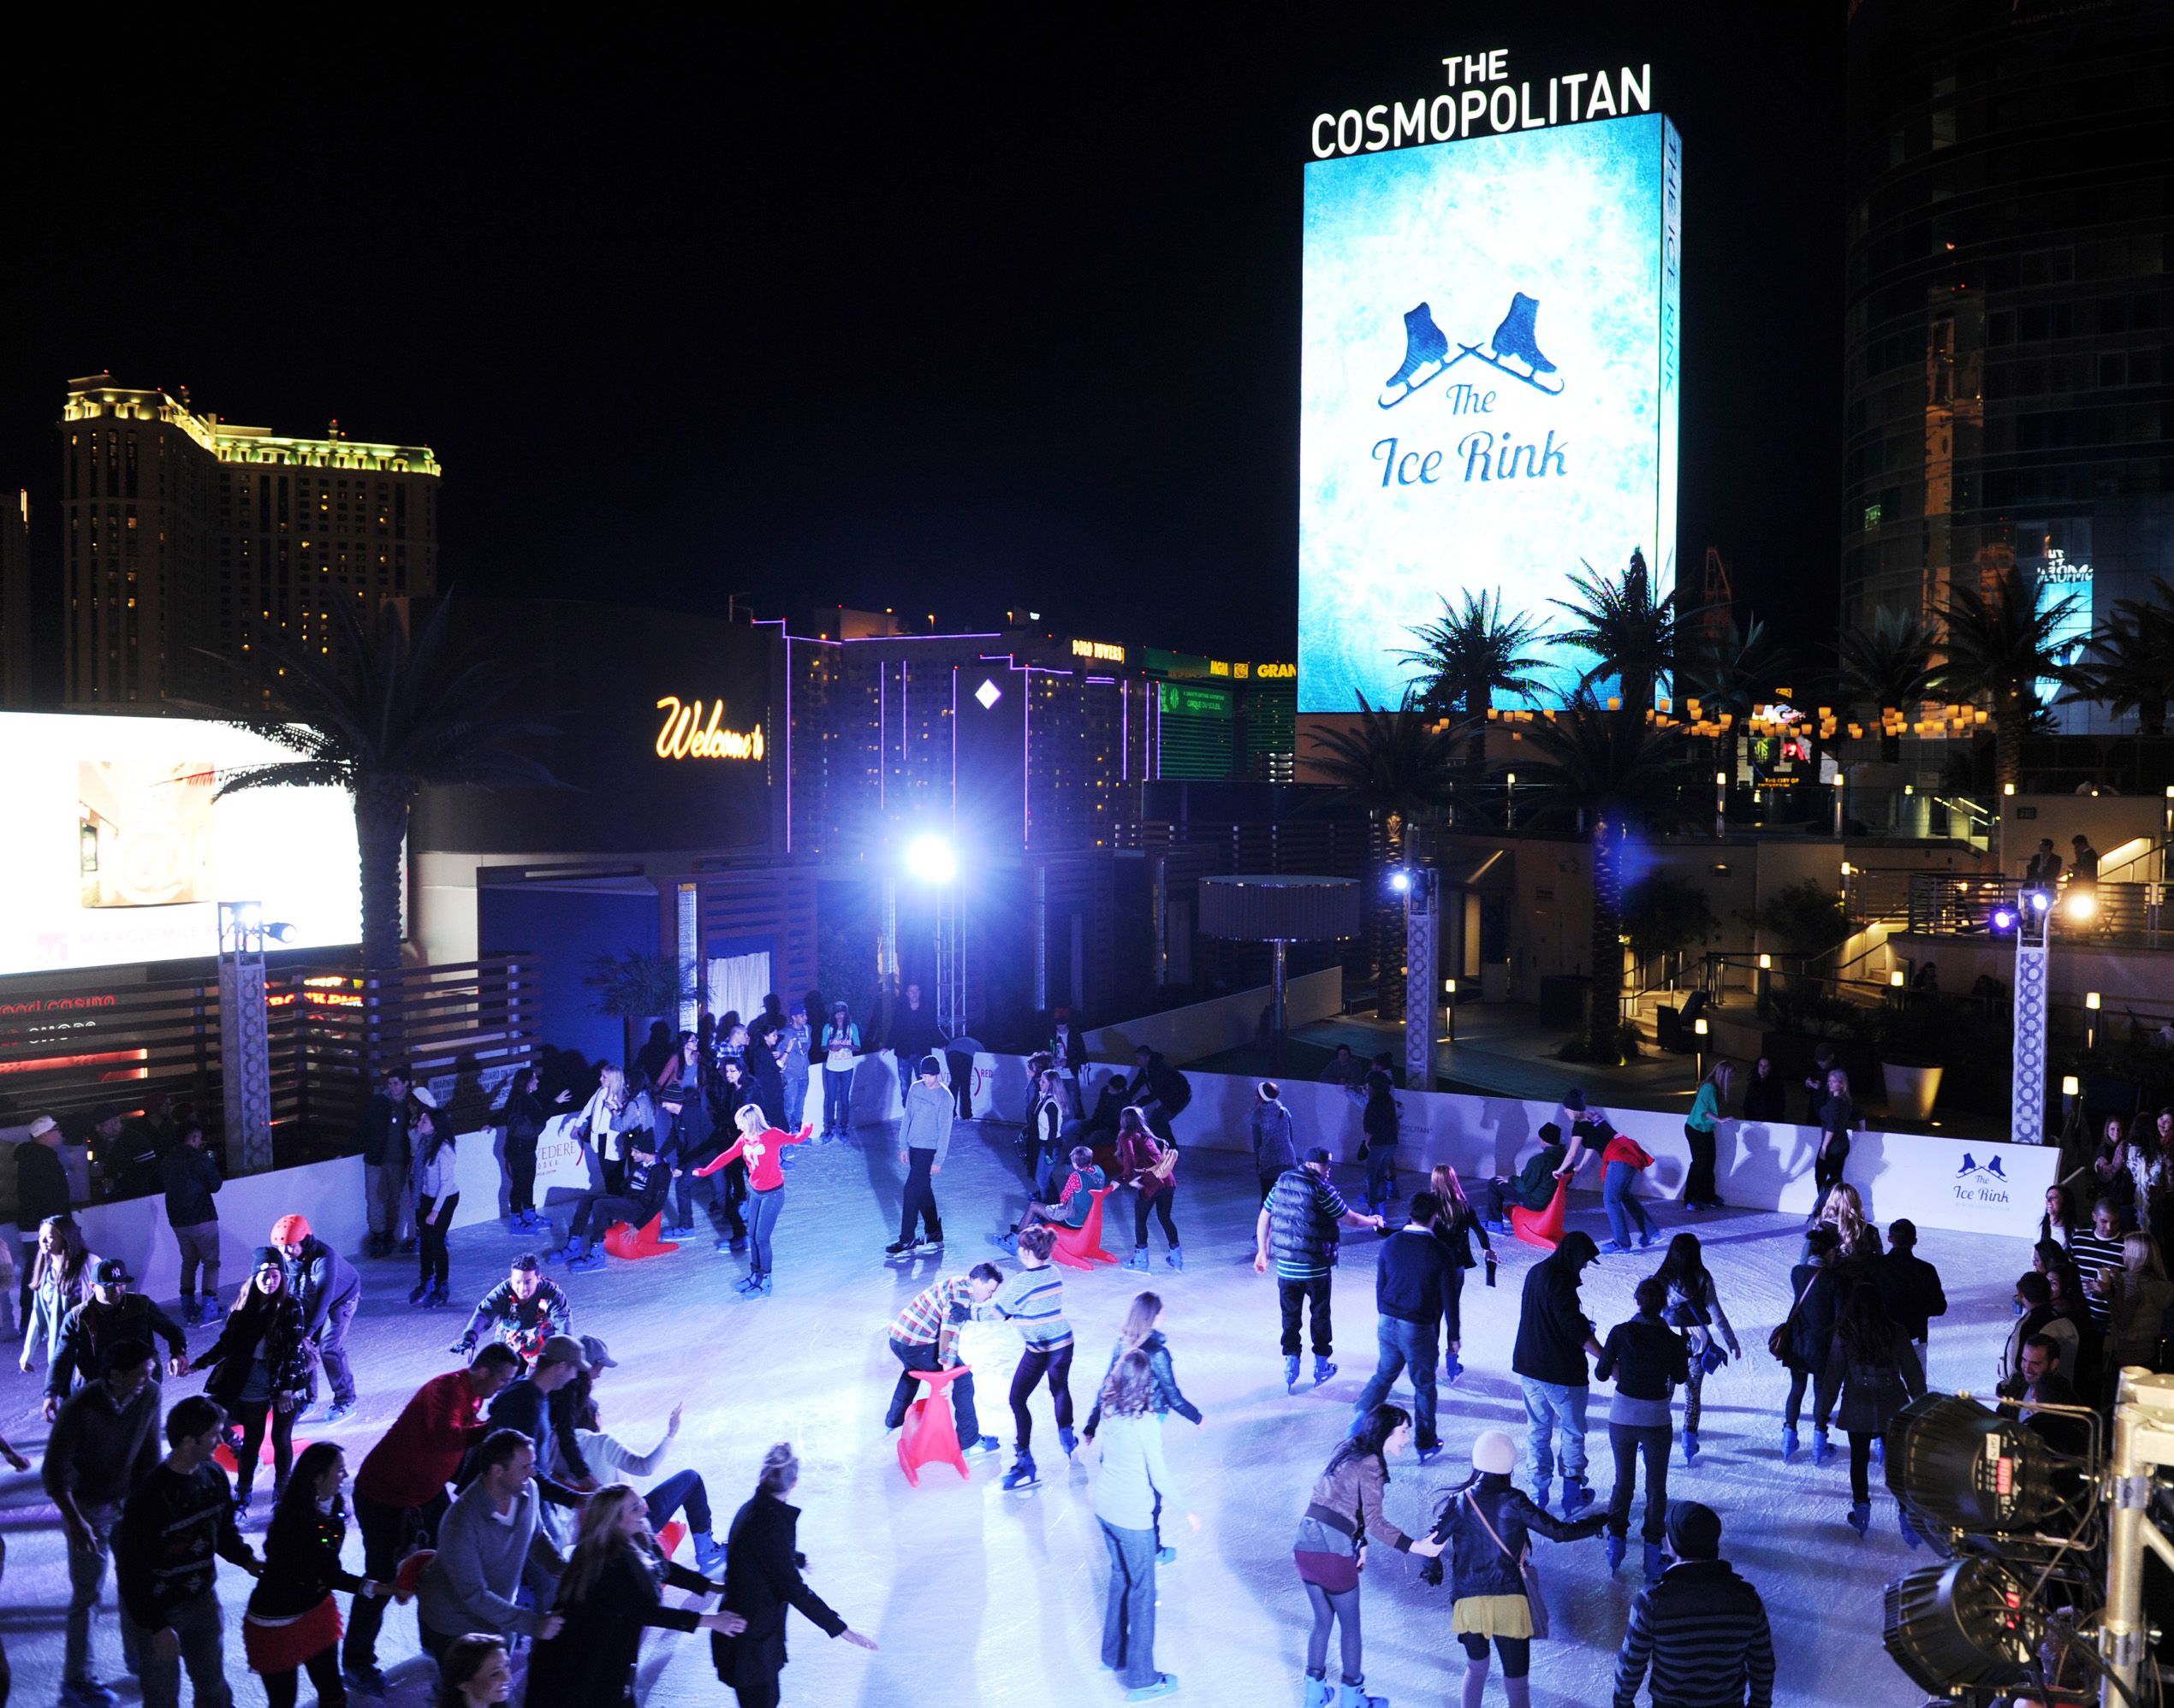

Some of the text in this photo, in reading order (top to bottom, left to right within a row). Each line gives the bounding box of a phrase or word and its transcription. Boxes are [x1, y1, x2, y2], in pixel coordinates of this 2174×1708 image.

[1442, 49, 1509, 86] THE
[1311, 64, 1652, 158] COSMOPOLITAN
[1667, 141, 1678, 213] THE
[1666, 225, 1677, 288] ICE
[1446, 383, 1497, 415] The
[1371, 430, 1569, 488] Ice Rink
[1210, 660, 1298, 678] MGM GRAN
[656, 696, 752, 760] Welcome
[1953, 1185, 2010, 1203] Ice Rink
[1975, 1175, 1990, 1184] The
